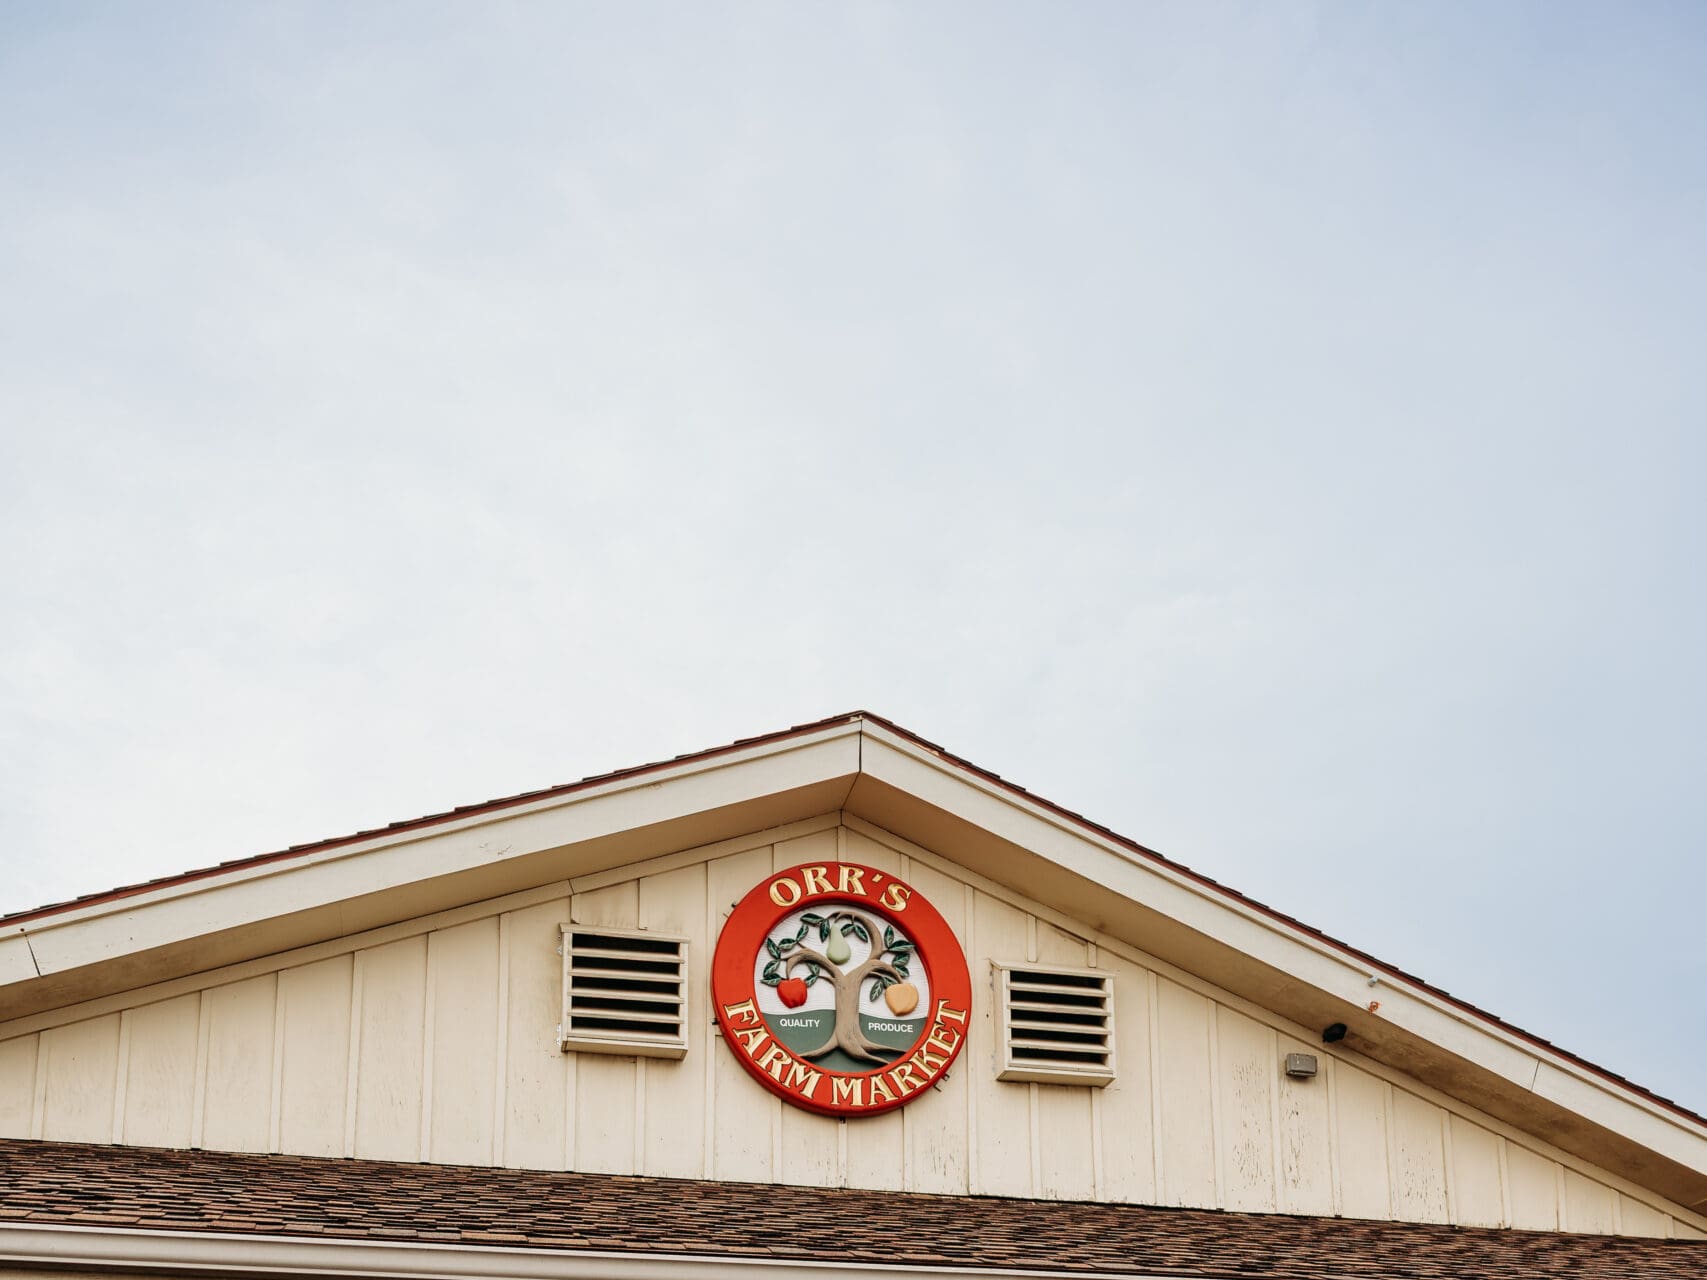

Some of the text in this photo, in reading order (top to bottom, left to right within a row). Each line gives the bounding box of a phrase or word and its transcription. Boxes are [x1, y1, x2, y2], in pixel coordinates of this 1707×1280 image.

[769, 865, 912, 912] ORR'S
[780, 1018, 821, 1028] QUALITY
[868, 1022, 913, 1033] PRODUCE
[724, 998, 966, 1106] FARM MARKET
